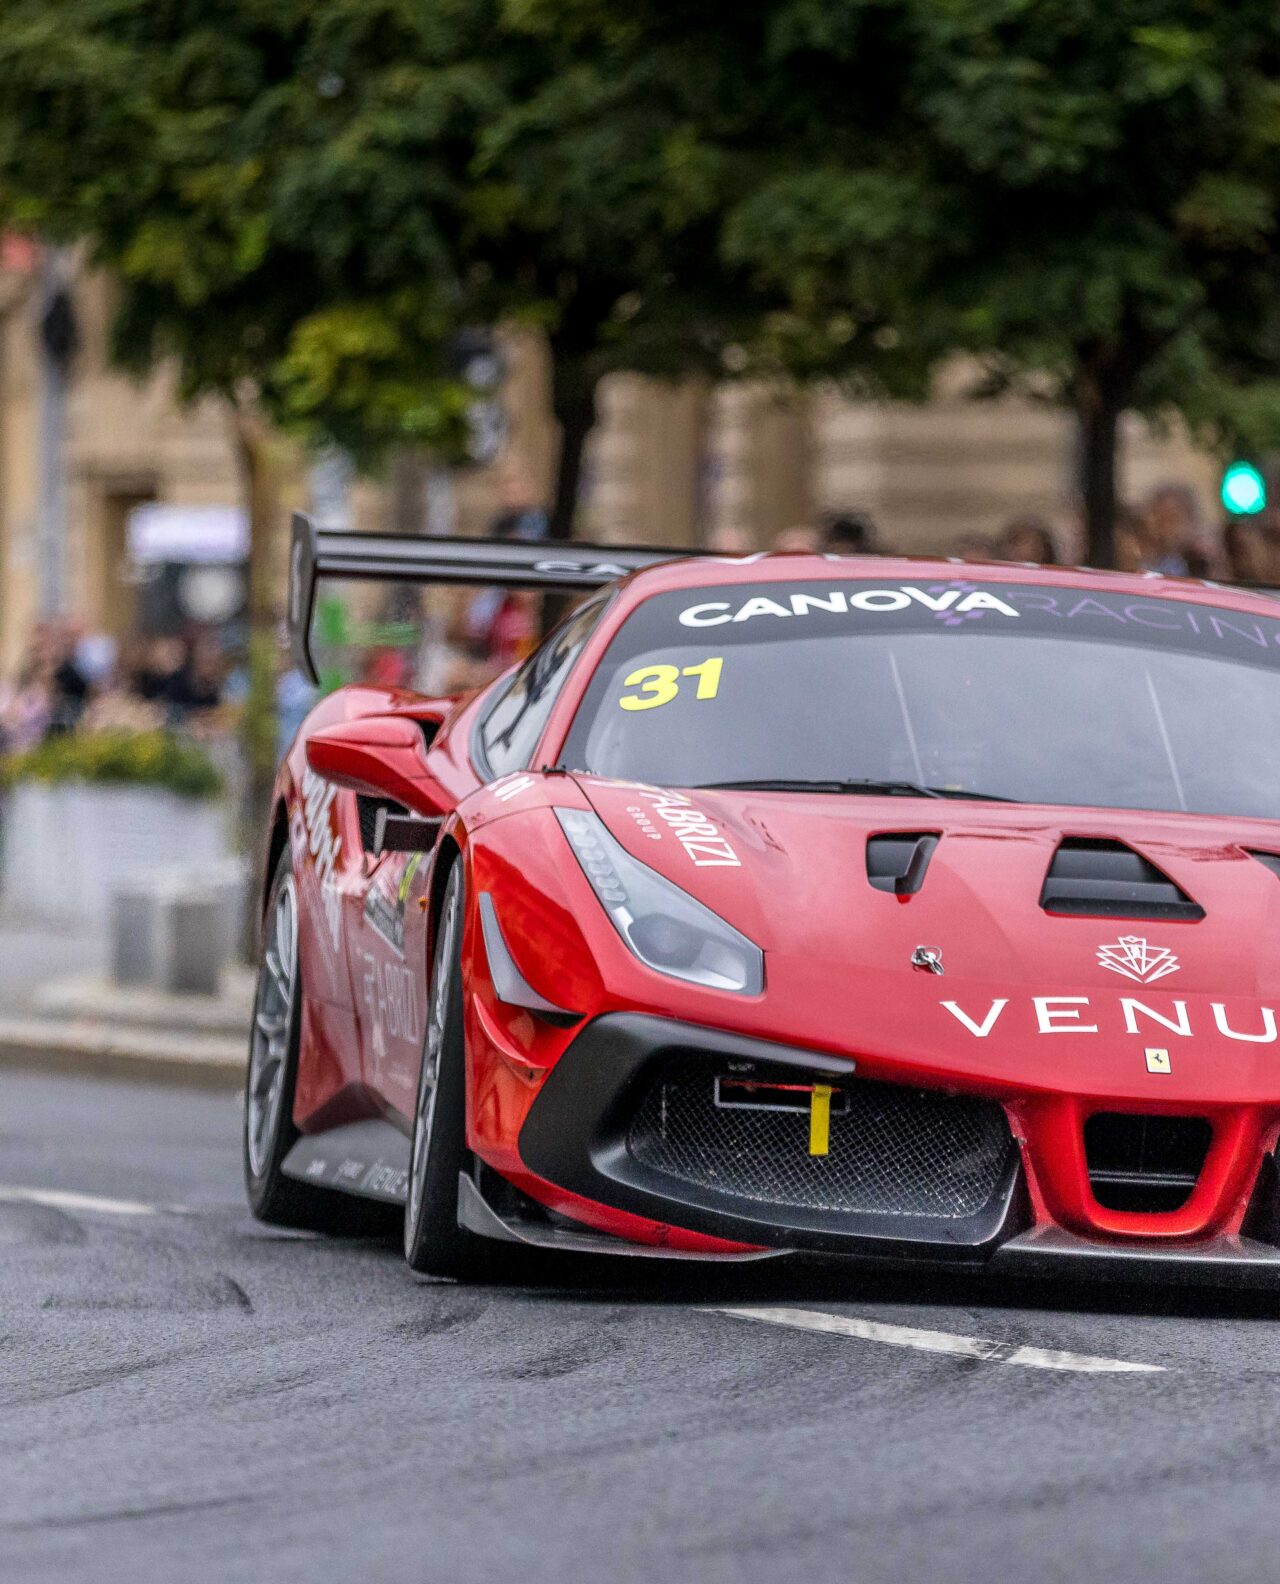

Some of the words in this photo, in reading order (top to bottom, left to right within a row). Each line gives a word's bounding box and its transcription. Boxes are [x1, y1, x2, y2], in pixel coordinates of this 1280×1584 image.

[679, 586, 1021, 627] CANOVA
[619, 656, 724, 711] 31
[626, 806, 662, 840] GROUP
